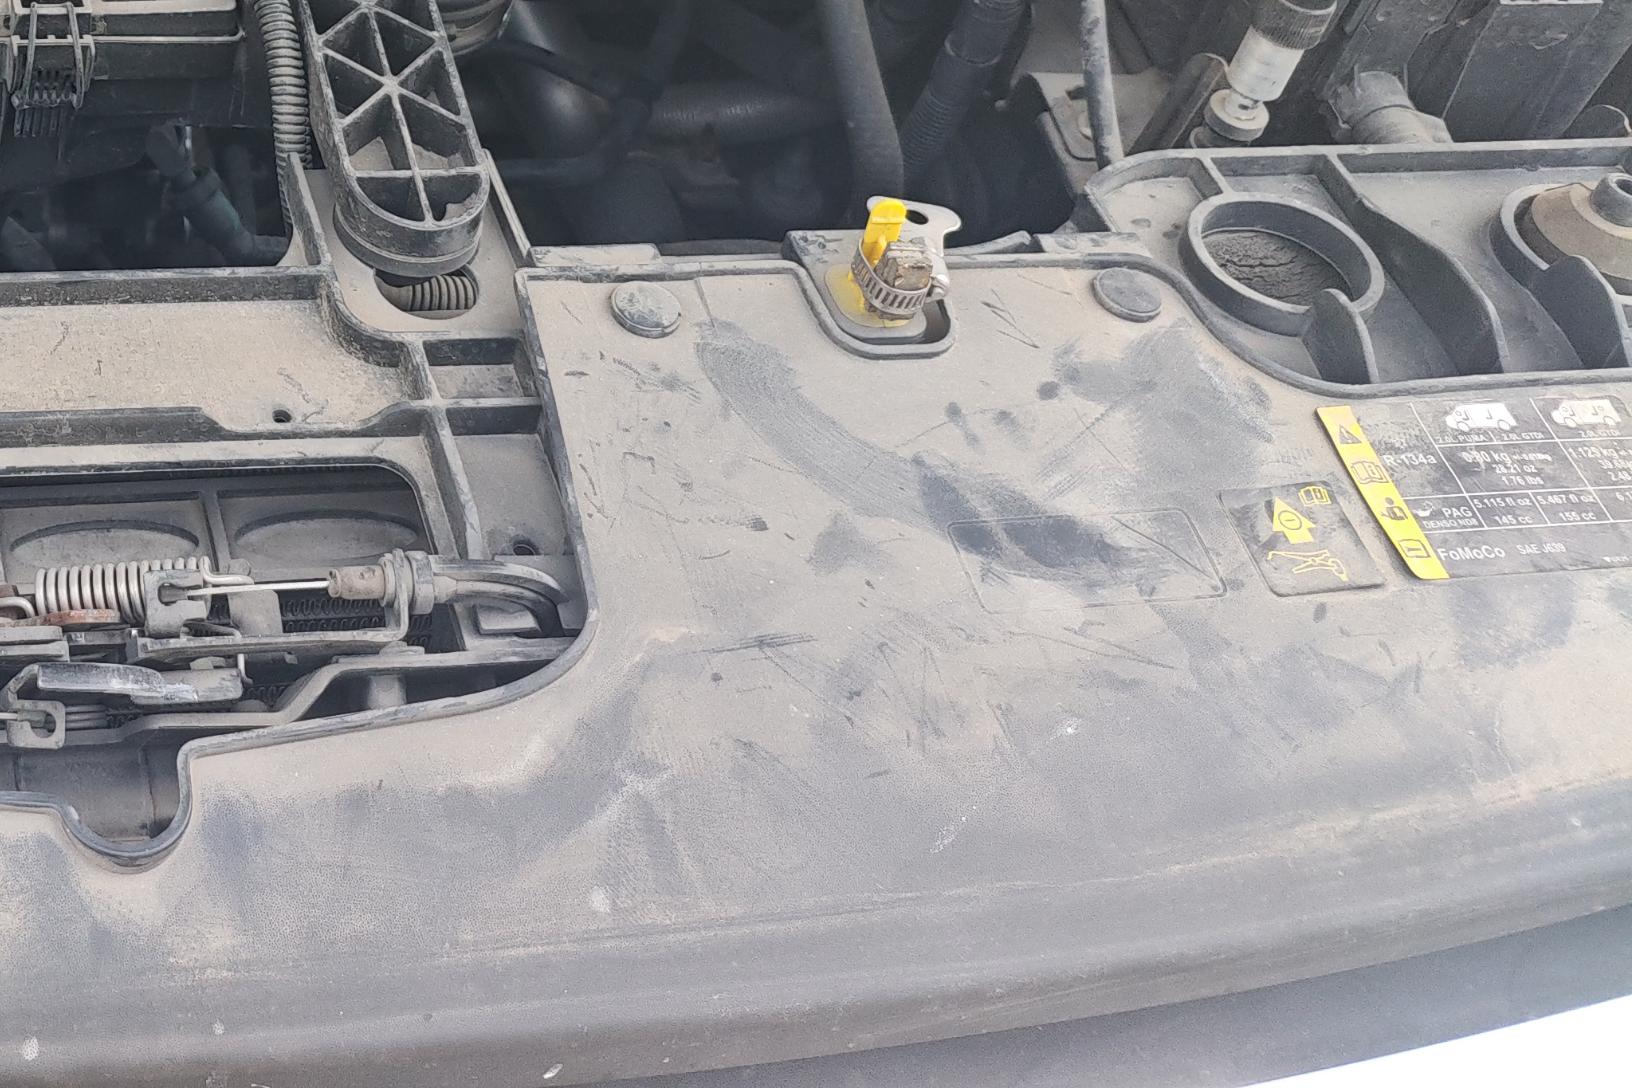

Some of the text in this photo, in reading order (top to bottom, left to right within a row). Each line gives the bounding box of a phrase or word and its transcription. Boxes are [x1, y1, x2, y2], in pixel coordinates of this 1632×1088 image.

[1490, 450, 1512, 464] kg
[1598, 445, 1620, 461] kg
[1382, 453, 1438, 466] R-134a
[1492, 464, 1539, 473] 28.21 oz
[1502, 475, 1545, 485] 1.76 lbs
[1473, 497, 1506, 508] 5.115
[1516, 497, 1533, 506] oz
[1580, 495, 1597, 503] oz
[1441, 506, 1473, 518] PAG
[1581, 512, 1597, 521] cc
[1494, 515, 1533, 525] 145 cc
[1436, 545, 1506, 561] FoMoCo
[1516, 542, 1567, 555] SAE J639
